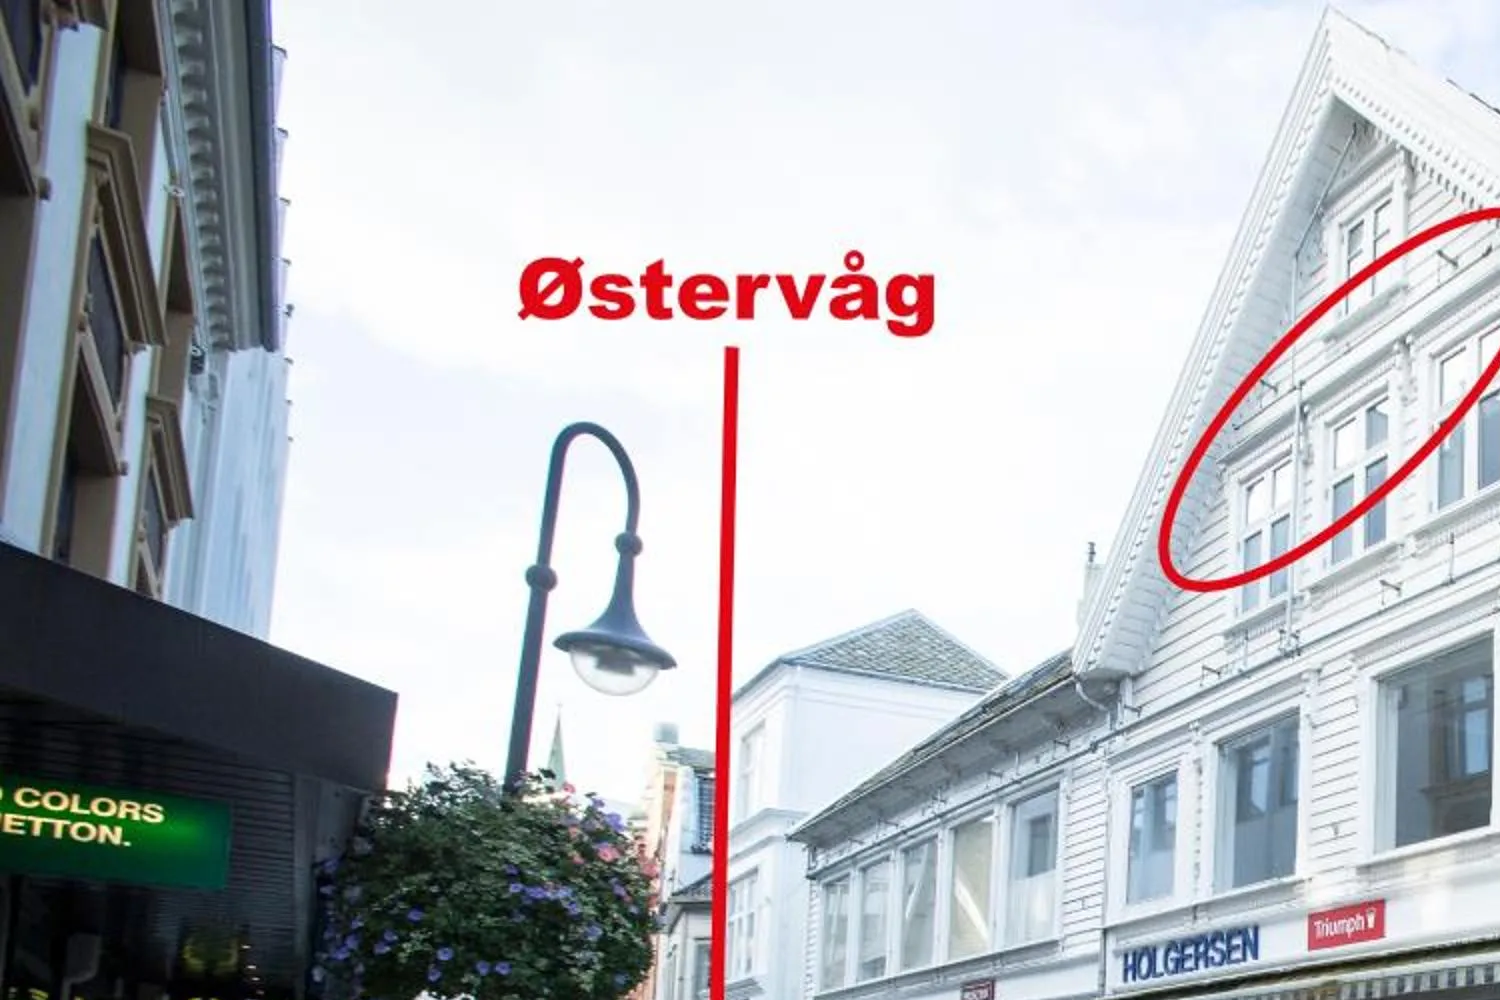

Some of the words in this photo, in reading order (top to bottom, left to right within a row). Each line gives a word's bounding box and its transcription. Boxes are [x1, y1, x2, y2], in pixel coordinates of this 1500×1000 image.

[13, 786, 165, 824] COLORS
[0, 812, 132, 847] ETTON.
[1313, 913, 1365, 940] Triumph
[1123, 924, 1260, 983] HOLGERSEN
